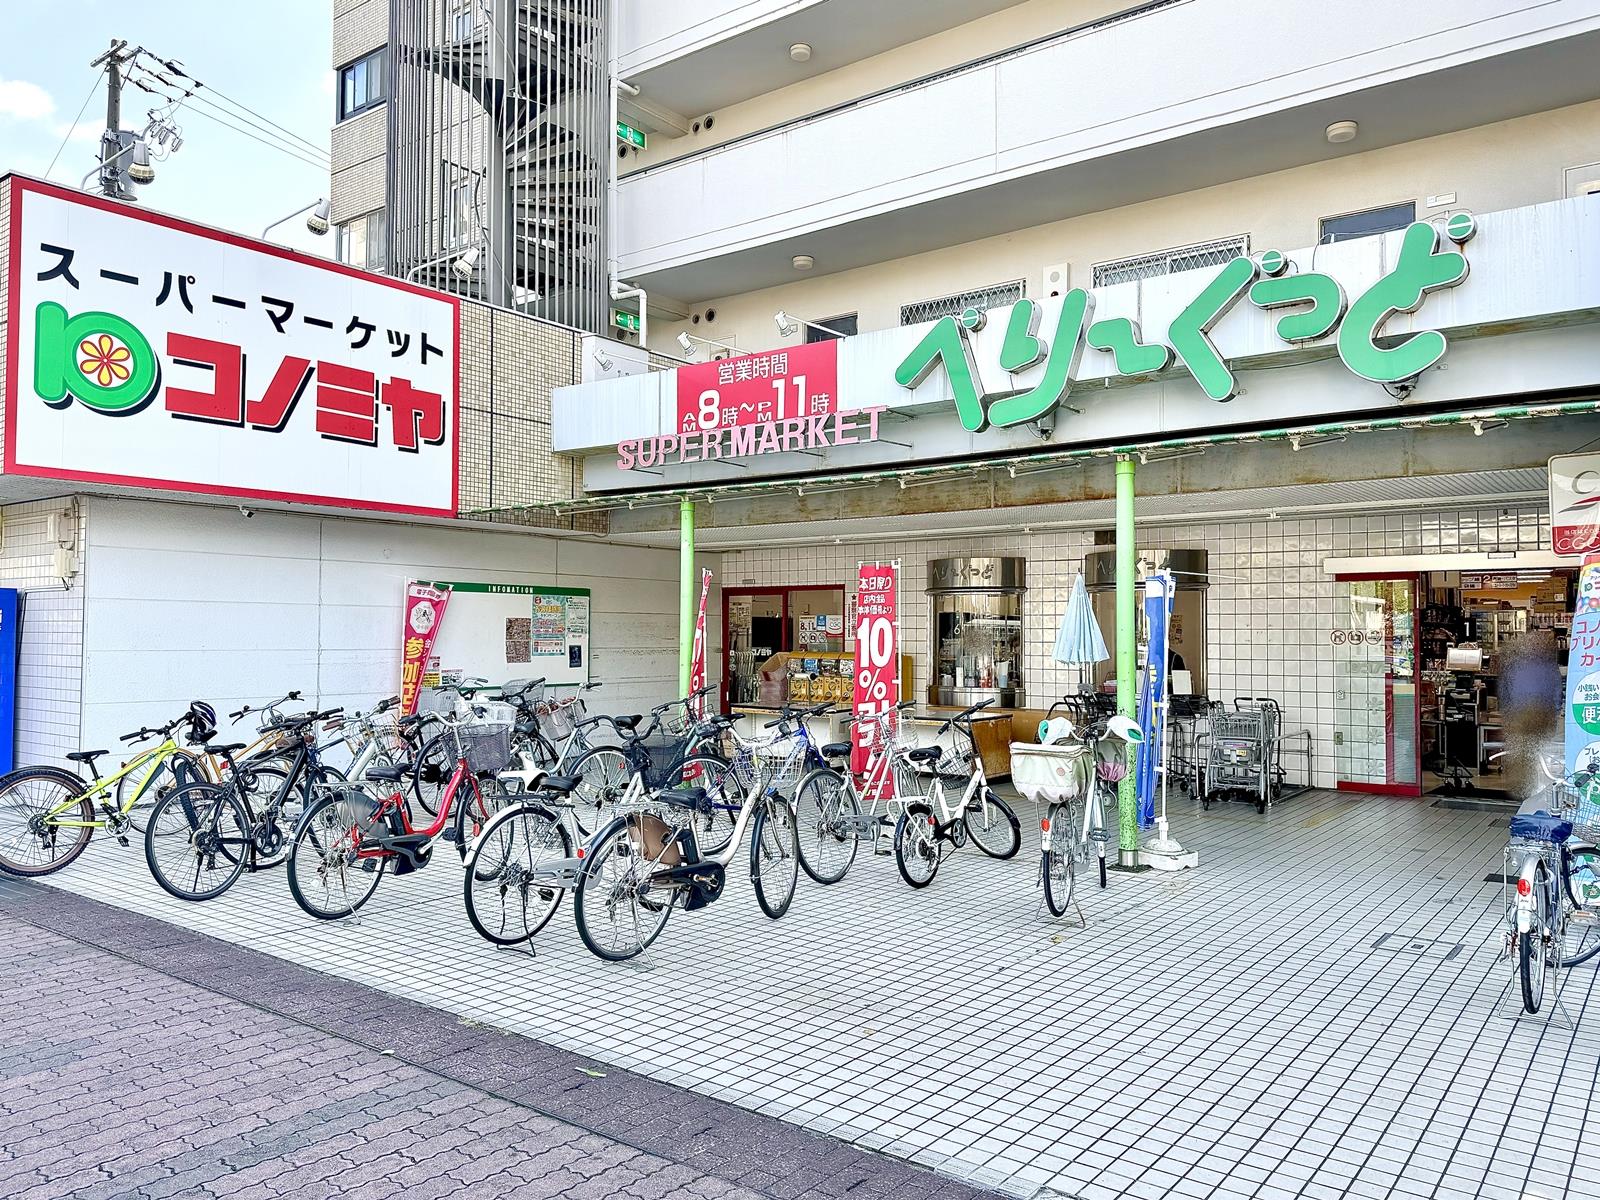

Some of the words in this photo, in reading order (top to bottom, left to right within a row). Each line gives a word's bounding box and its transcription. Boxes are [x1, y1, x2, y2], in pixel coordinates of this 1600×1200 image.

[37, 243, 445, 365] スーパーマーケット
[718, 352, 789, 386] 営業時間
[164, 331, 446, 453] コノミヤ
[616, 428, 725, 471] SUPER
[730, 405, 888, 458] MARKET
[1482, 574, 1491, 584] 2
[953, 623, 961, 635] 6
[1463, 621, 1470, 637] 1
